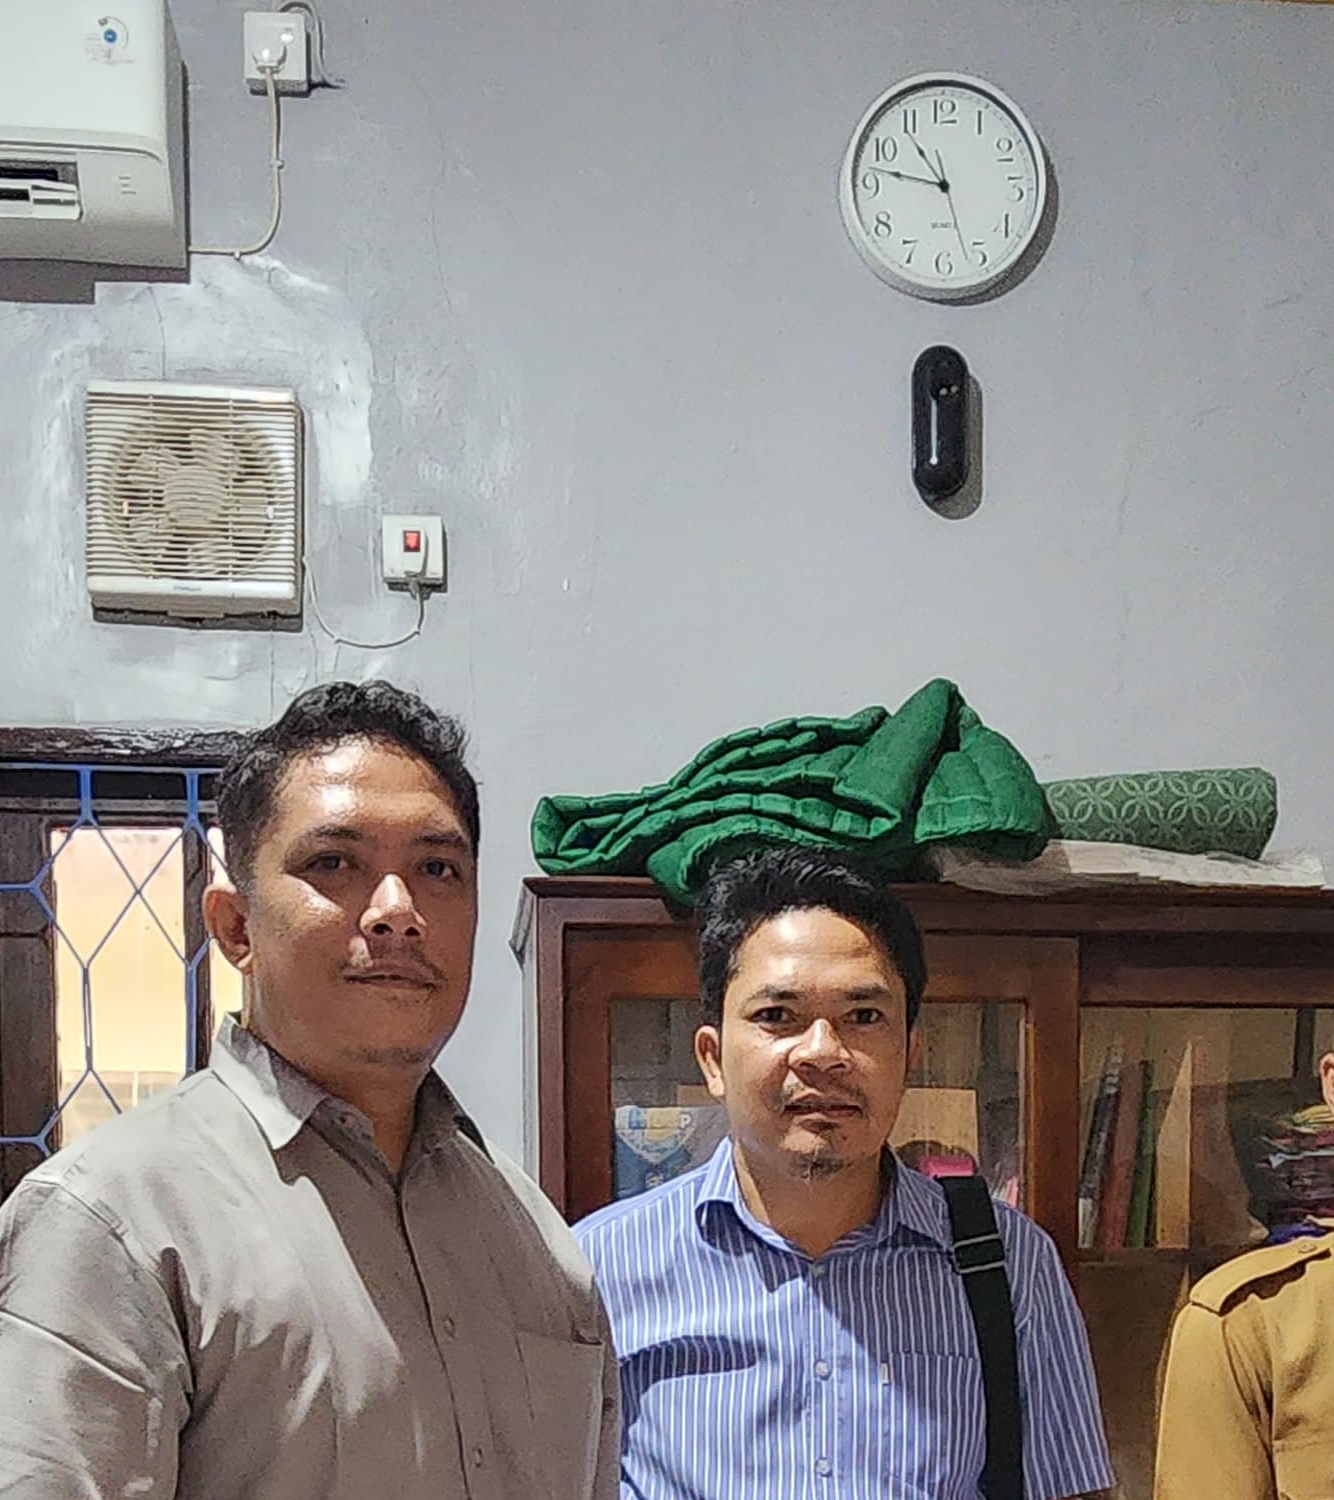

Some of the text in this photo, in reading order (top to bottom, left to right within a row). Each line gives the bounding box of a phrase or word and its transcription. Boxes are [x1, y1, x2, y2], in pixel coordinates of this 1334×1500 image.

[903, 109, 918, 135] 11
[932, 99, 957, 125] 12
[975, 110, 984, 135] 1
[875, 137, 898, 162] 10
[996, 138, 1014, 163] 2
[862, 174, 881, 199] 9
[1007, 176, 1025, 203] 3
[874, 211, 893, 237] 8
[993, 213, 1013, 239] 4
[901, 239, 920, 265] 7
[934, 251, 953, 277] 6
[971, 241, 988, 267] 5
